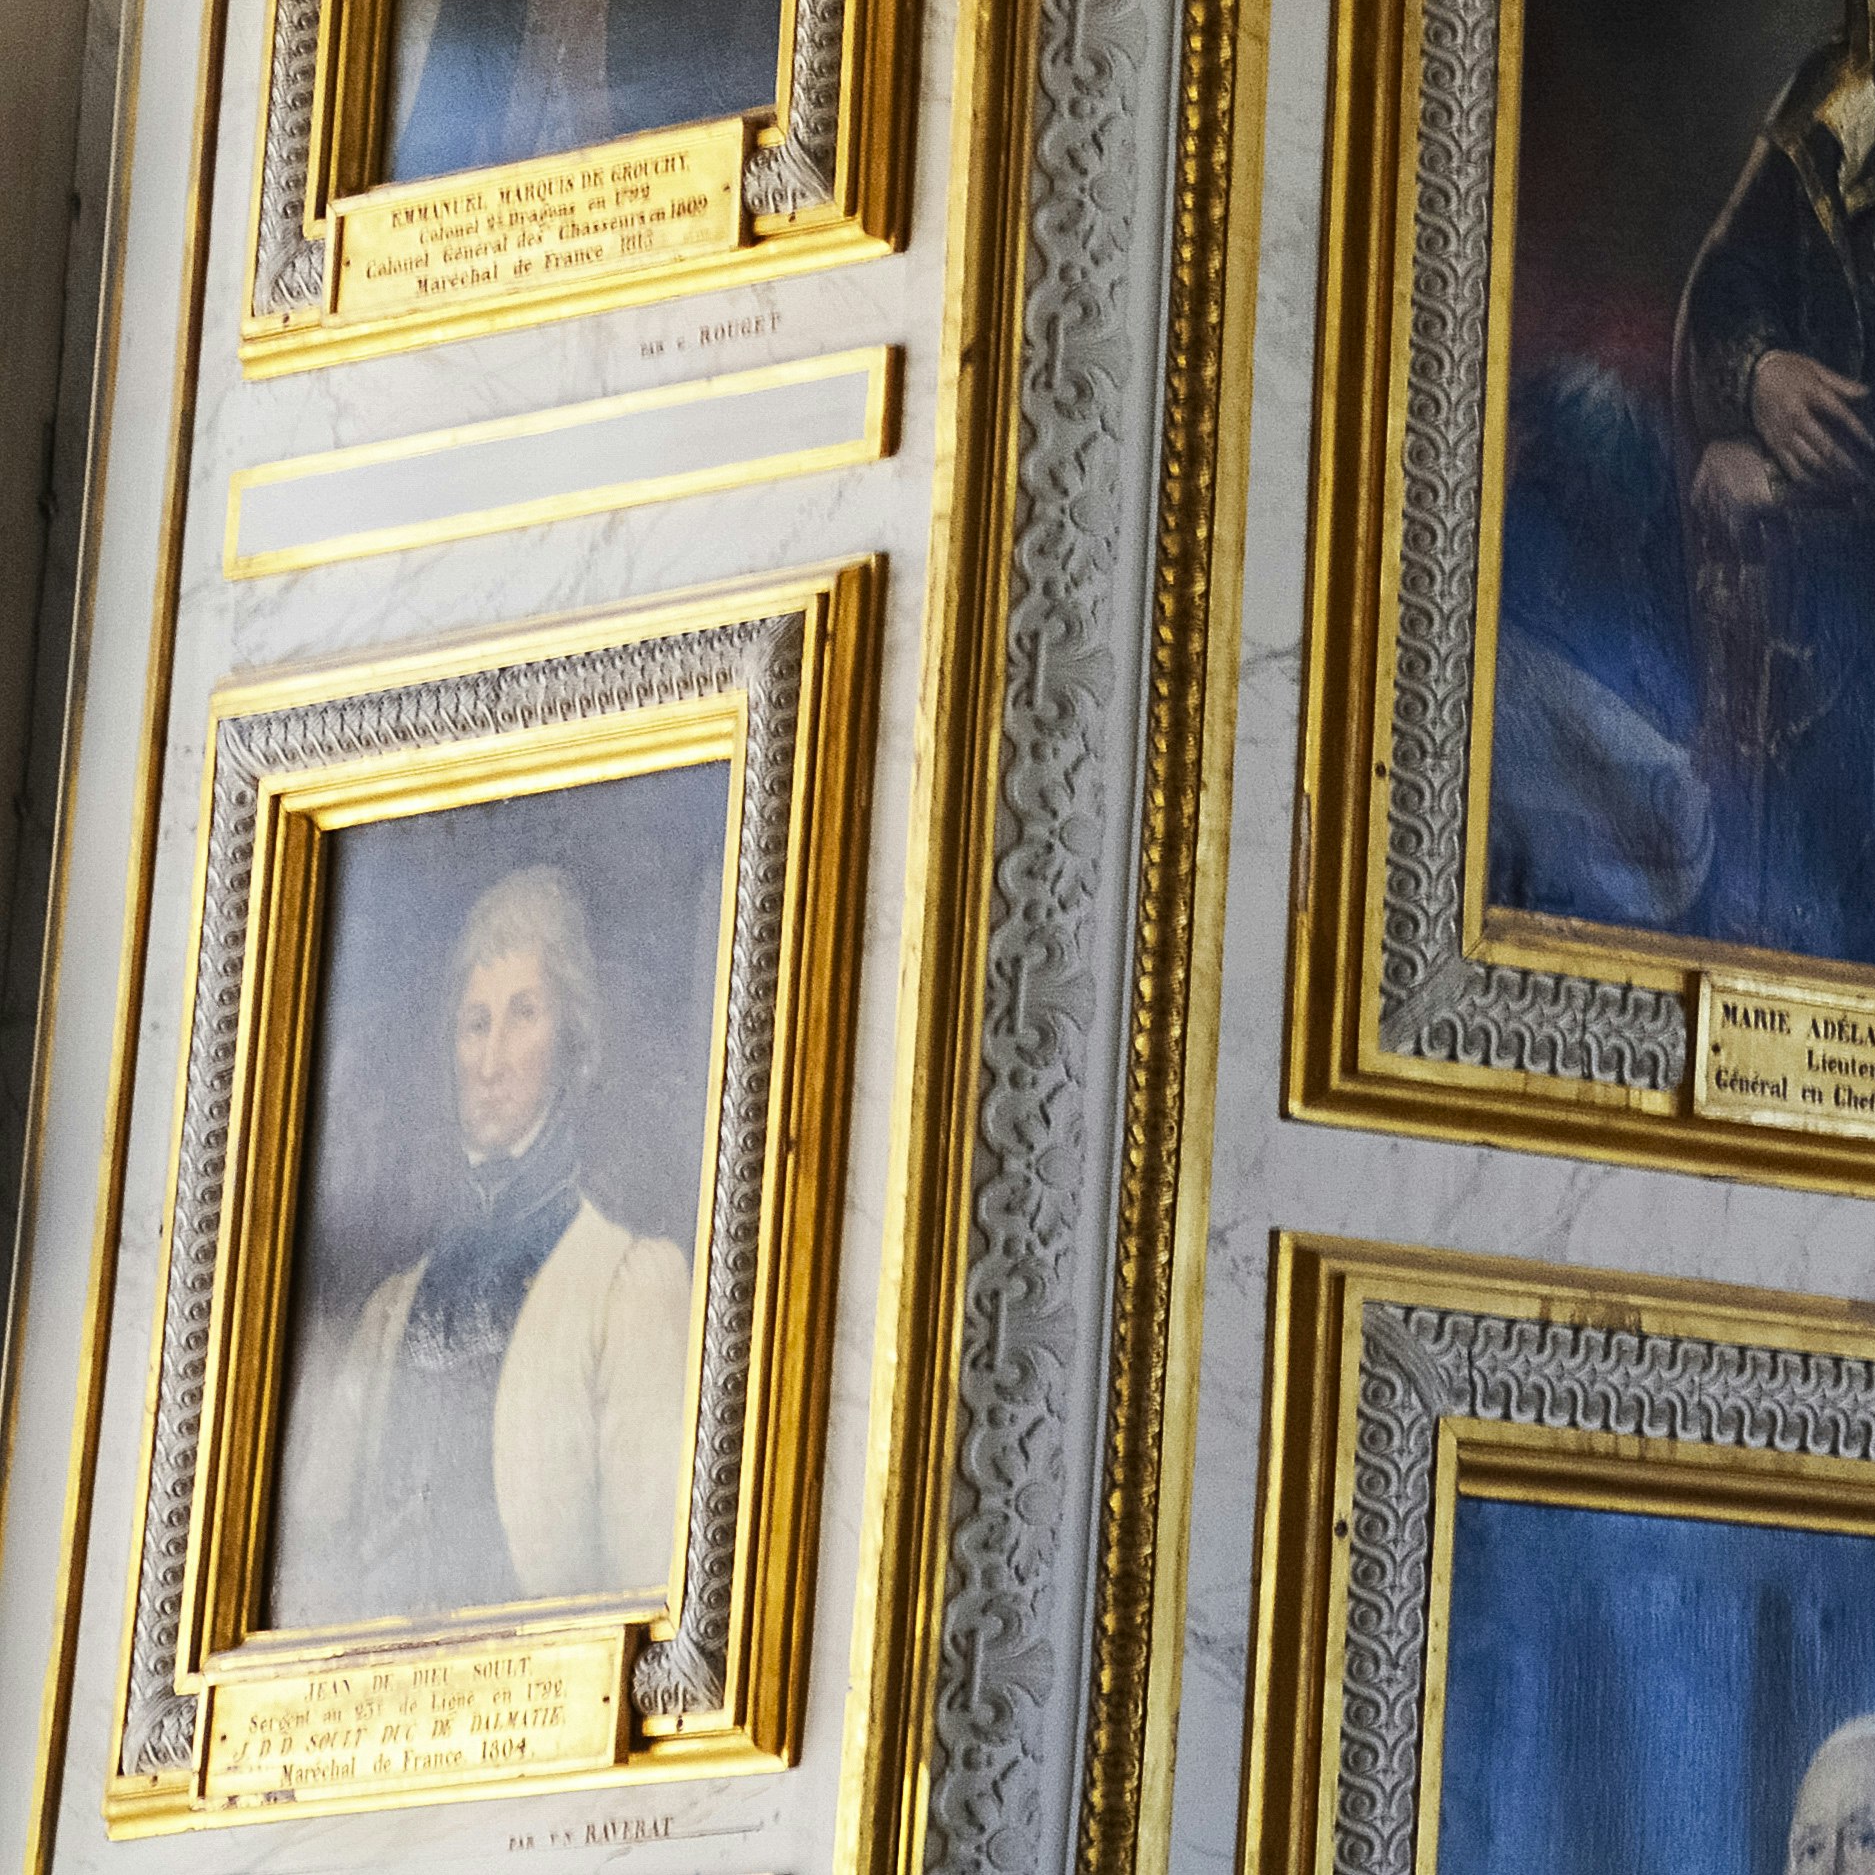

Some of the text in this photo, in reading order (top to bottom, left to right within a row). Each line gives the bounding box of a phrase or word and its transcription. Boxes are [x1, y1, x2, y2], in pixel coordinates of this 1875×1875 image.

[499, 176, 574, 205] MARQUIS
[581, 170, 604, 190] DE
[420, 220, 479, 245] Colonel
[508, 204, 576, 229] Dragons
[588, 196, 606, 212] en
[366, 252, 430, 279] Colonel
[443, 235, 508, 263] Général
[517, 230, 544, 249] des
[559, 213, 646, 241] Chasseurs
[416, 264, 499, 295] Maréchal
[513, 258, 532, 277] de
[544, 244, 603, 270] France
[700, 312, 782, 346] ROUGET
[1721, 1003, 1791, 1035] MARIE
[1715, 1065, 1788, 1102] Général
[1801, 1085, 1824, 1105] en
[304, 1679, 350, 1702] JEAN
[372, 1673, 394, 1692] DE
[412, 1667, 453, 1688] DIEU
[249, 1710, 310, 1735] Sergent
[323, 1709, 343, 1723] au
[399, 1697, 418, 1716] de
[431, 1690, 475, 1717] Ligne
[492, 1690, 512, 1705] en
[306, 1726, 368, 1754] SOULT
[381, 1722, 417, 1745] DUC
[431, 1717, 452, 1741] DE
[280, 1756, 357, 1788] Maréchal
[373, 1753, 392, 1774] de
[585, 1816, 675, 1845] RAVERAT
